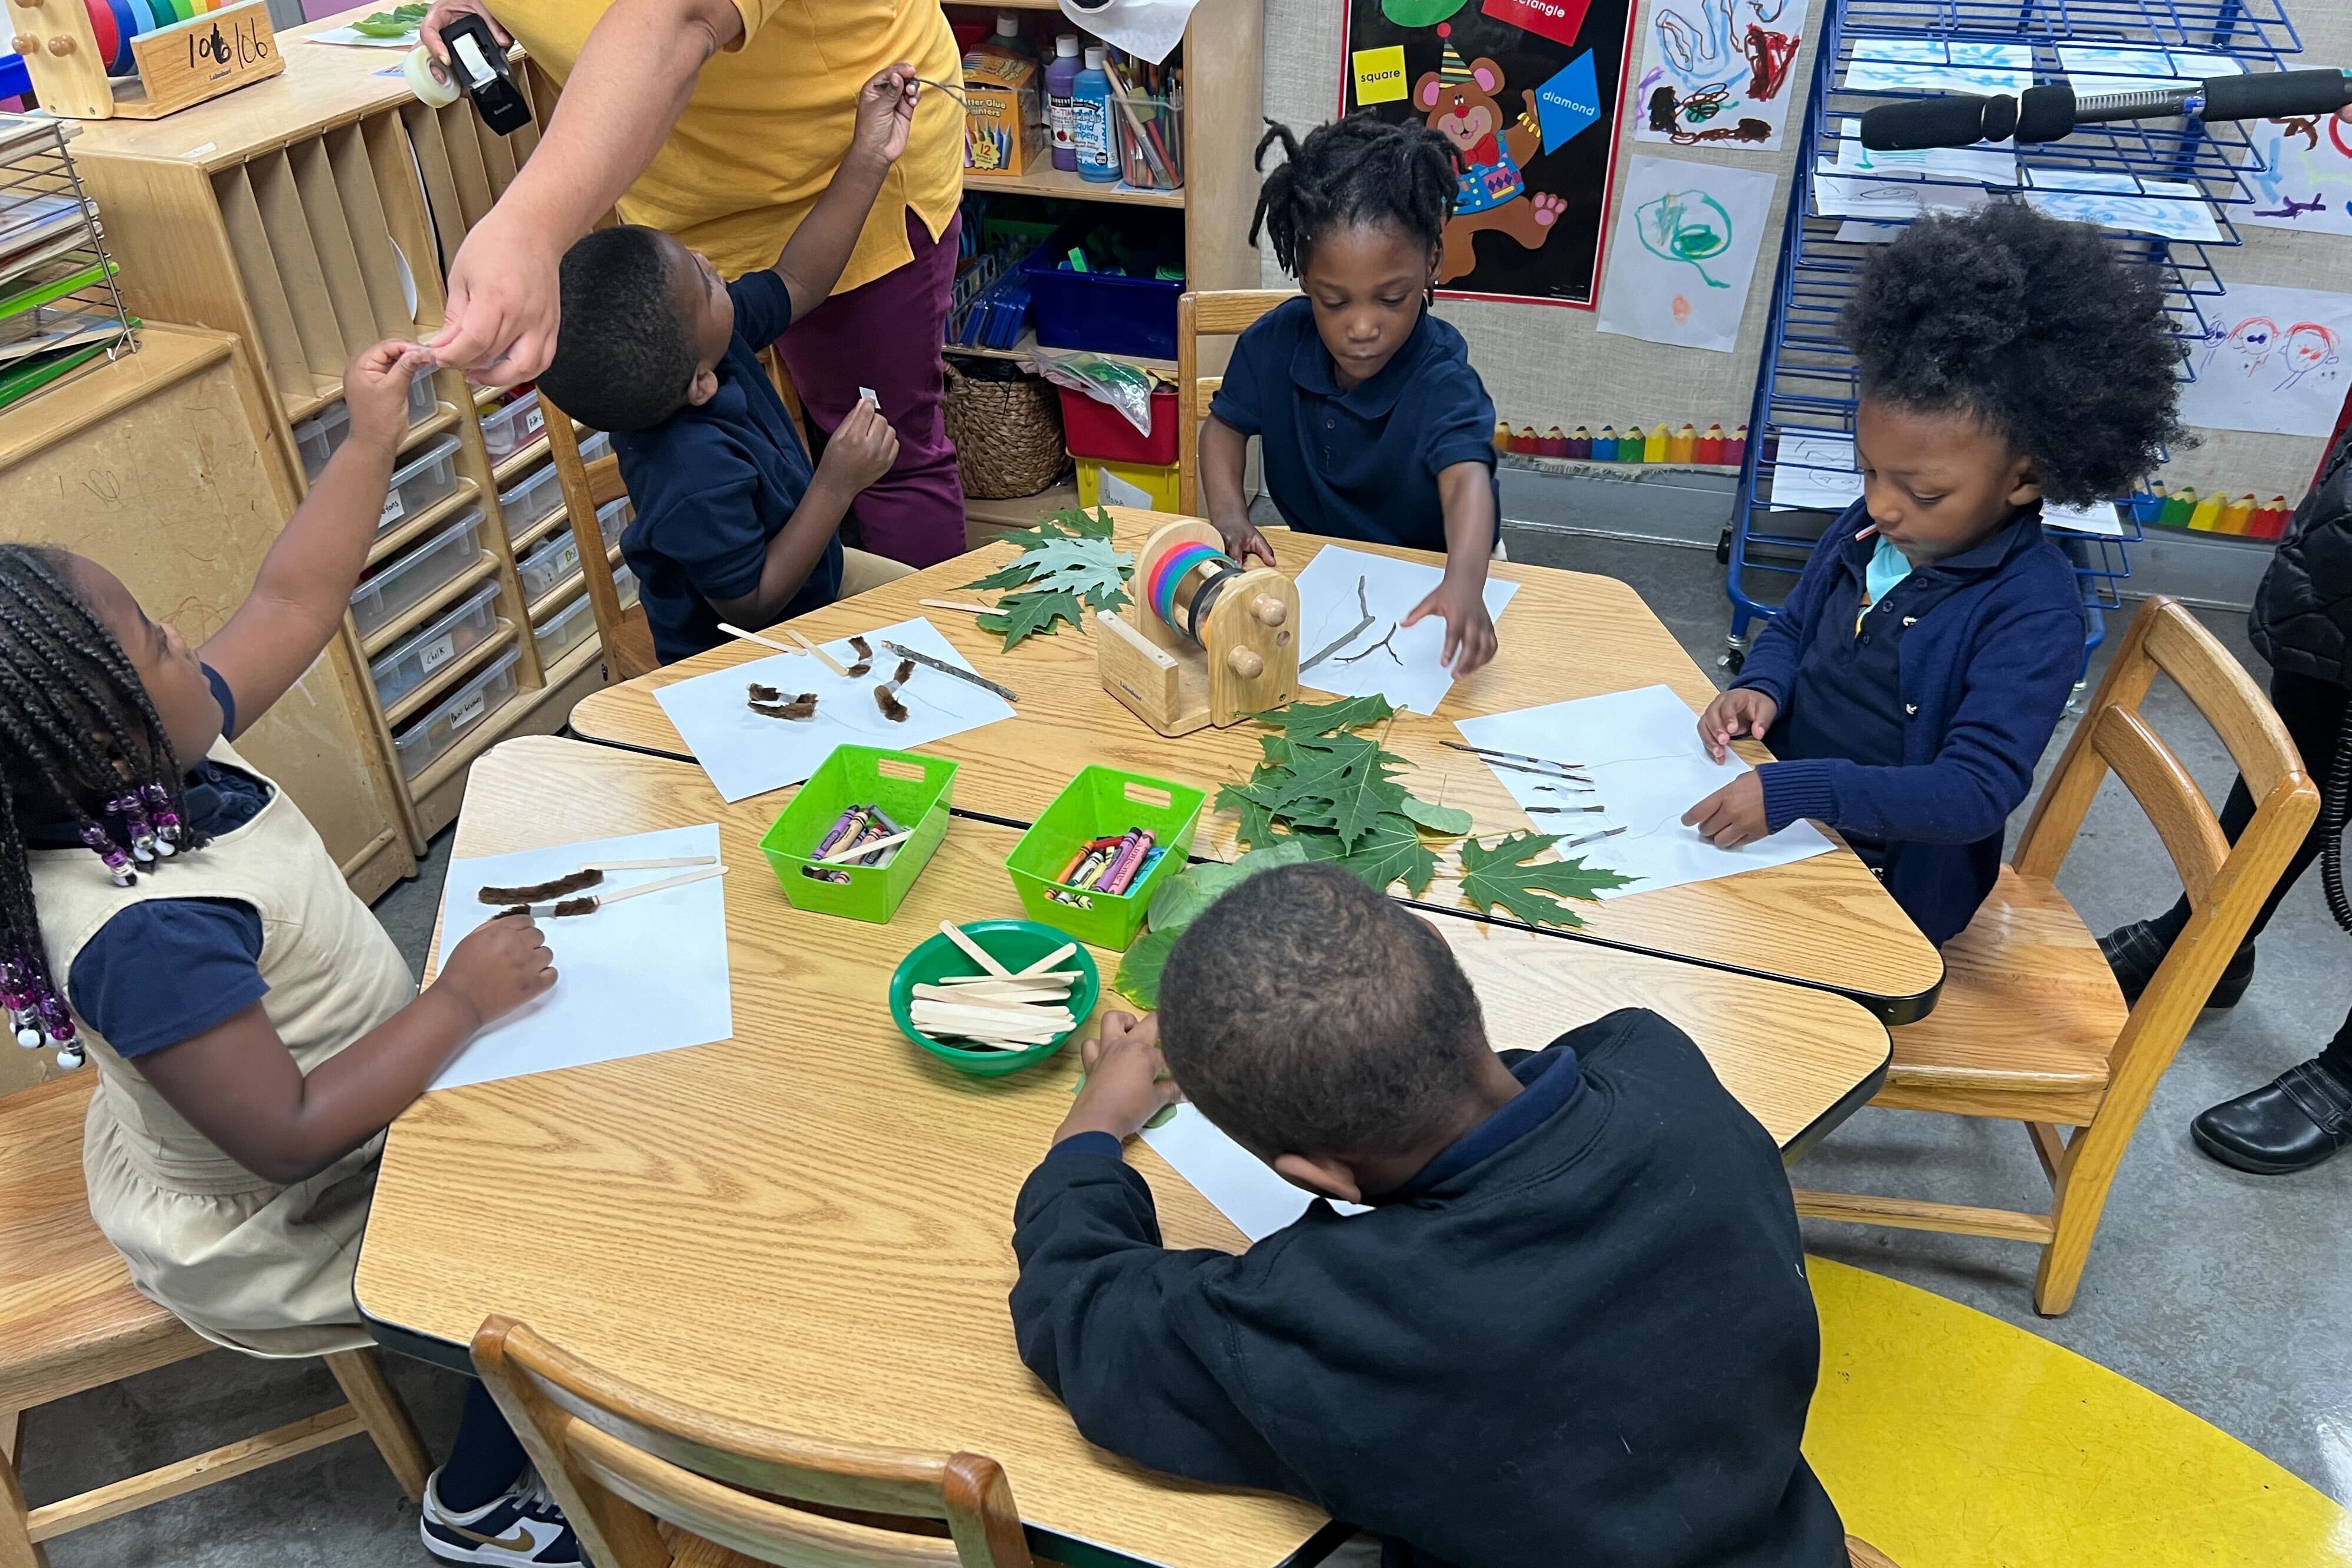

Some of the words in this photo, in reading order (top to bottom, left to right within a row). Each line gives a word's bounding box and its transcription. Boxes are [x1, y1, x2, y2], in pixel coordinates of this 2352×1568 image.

[235, 17, 268, 69] 106
[1361, 70, 1400, 83] square
[986, 99, 1006, 109] Glue
[1543, 91, 1595, 116] diamond
[980, 143, 991, 156] 12
